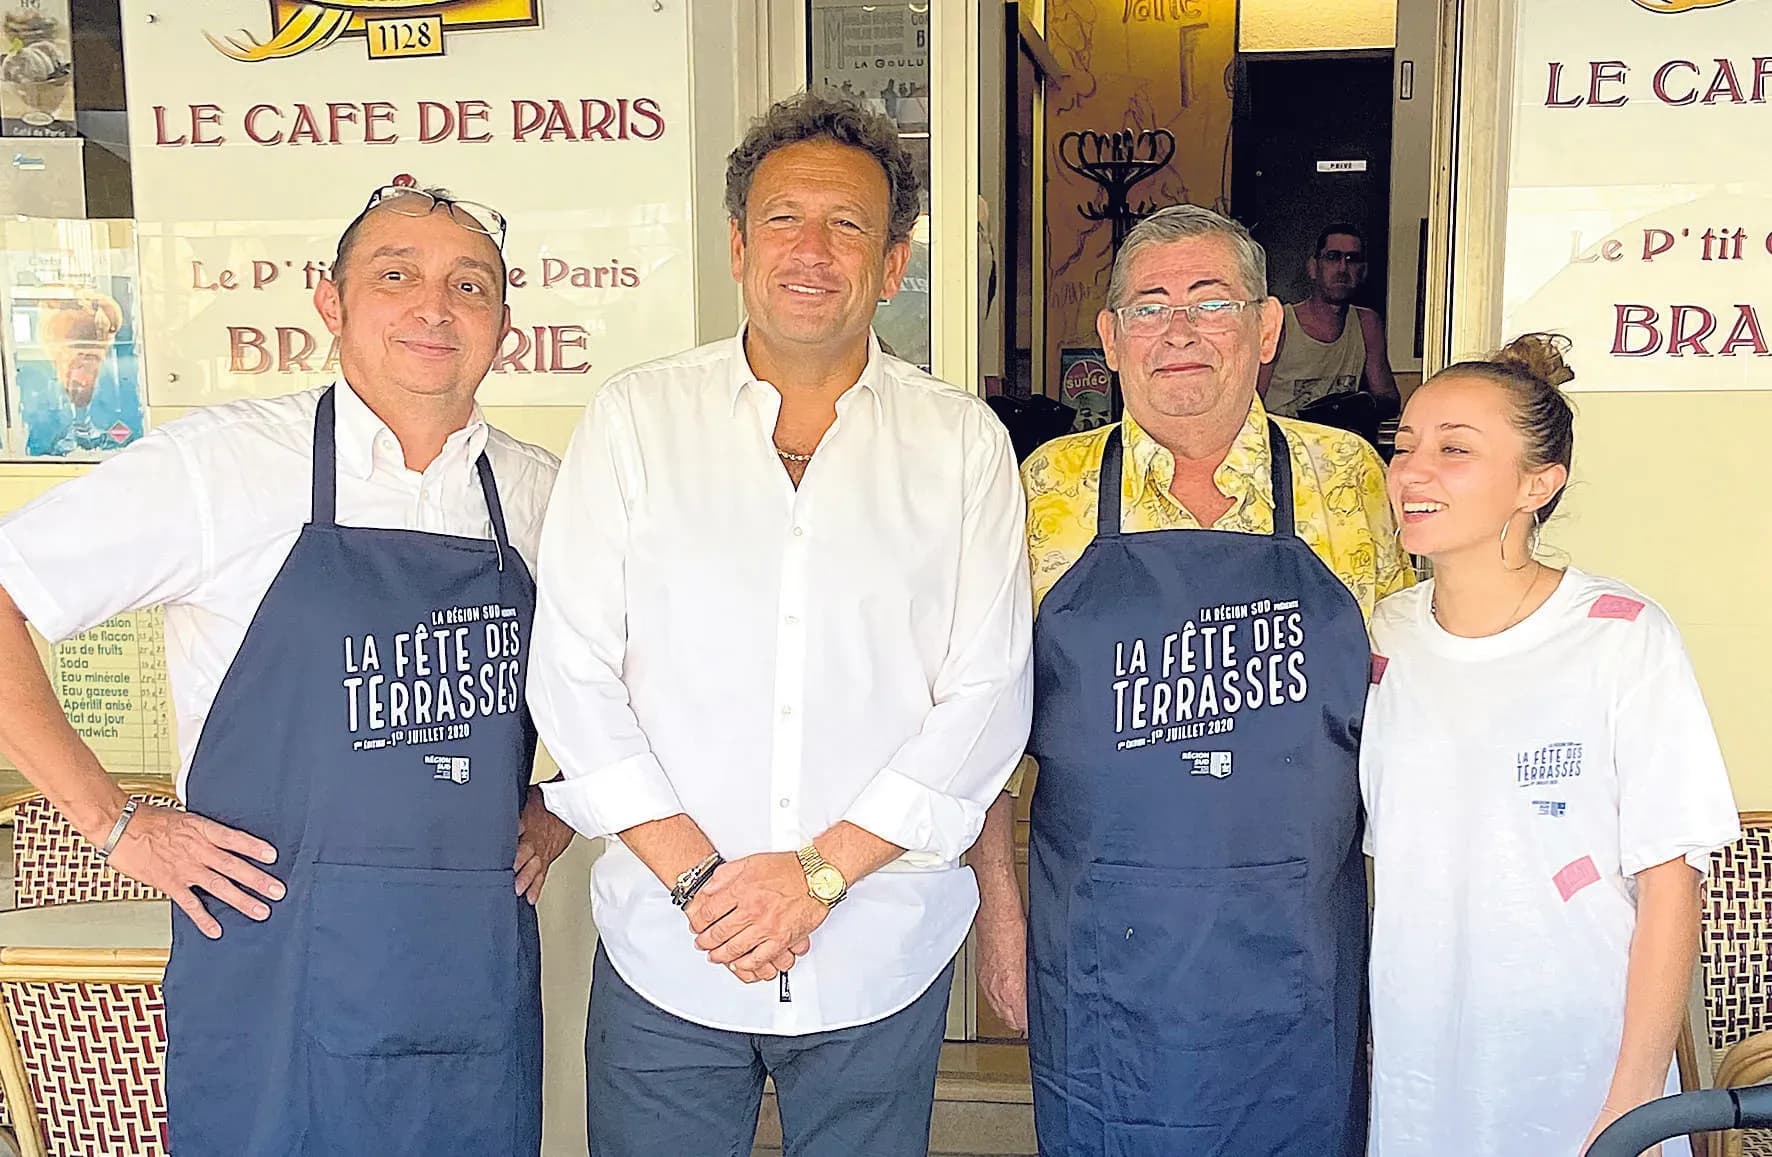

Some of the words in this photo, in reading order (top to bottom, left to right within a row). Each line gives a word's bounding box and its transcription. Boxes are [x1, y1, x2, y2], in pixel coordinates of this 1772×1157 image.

[378, 22, 432, 54] 1128
[854, 61, 868, 69] LA
[1544, 61, 1632, 108] LE
[151, 104, 225, 147] LE
[243, 102, 399, 146] CAFE
[417, 100, 494, 144] DE
[511, 97, 666, 143] PARIS
[1570, 231, 1623, 264] Le
[192, 260, 239, 291] Le
[542, 258, 641, 288] Paris
[432, 610, 444, 626] LA
[446, 606, 480, 624] RÉGION
[482, 604, 500, 619] SUD
[1200, 608, 1212, 622] LA
[1214, 604, 1248, 621] RÉGION
[1250, 600, 1271, 615] SUD
[59, 643, 76, 655] Jus
[80, 643, 95, 655] de
[98, 643, 123, 656] fruits
[344, 634, 380, 673] LA
[395, 623, 471, 678] FÊTE
[485, 620, 520, 660] DES
[1115, 638, 1147, 676] LA
[1162, 621, 1237, 679] FÊTE
[1253, 613, 1304, 652] DES
[60, 657, 89, 669] Soda
[61, 671, 82, 682] Eau
[85, 671, 130, 684] minérale
[62, 685, 83, 696] Eau
[86, 687, 129, 699] gazeuse
[343, 660, 520, 732] TERRASSES
[1112, 651, 1308, 733] TERRASSES
[64, 697, 102, 712] Apéritif
[105, 699, 133, 711] anisé
[87, 712, 102, 724] du
[104, 712, 125, 727] jour
[1165, 722, 1206, 742] JUILLET
[1207, 717, 1234, 735] 2020
[406, 728, 444, 745] JUILLET
[447, 723, 471, 740] 2020
[1517, 751, 1529, 765] LA
[1566, 746, 1583, 760] DES
[1517, 760, 1582, 782] TERRASSES
